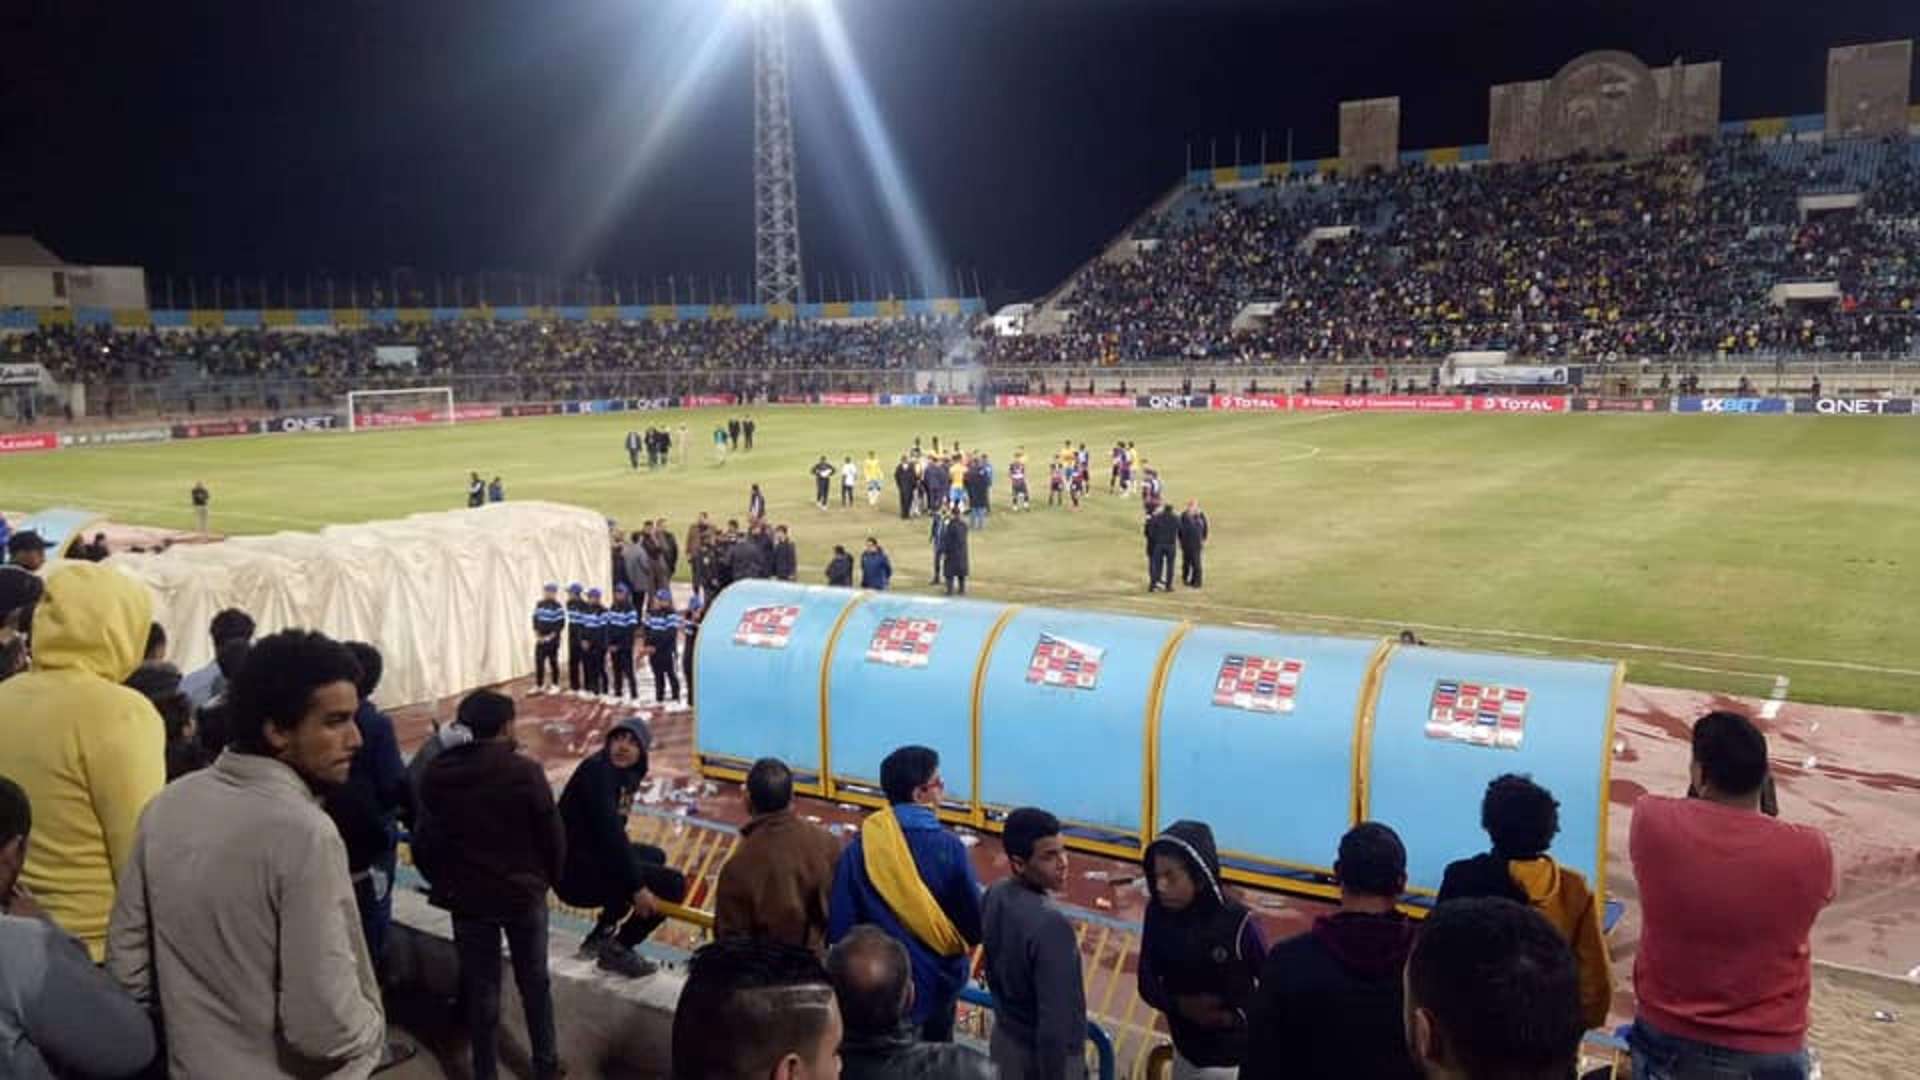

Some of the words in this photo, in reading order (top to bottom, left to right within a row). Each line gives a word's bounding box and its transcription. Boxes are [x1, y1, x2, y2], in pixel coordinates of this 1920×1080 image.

[1150, 396, 1193, 409] QNET
[1234, 397, 1279, 409] TOTAL
[1500, 398, 1553, 411] TOTAL
[1816, 399, 1889, 413] QNET
[282, 415, 335, 432] QNET
